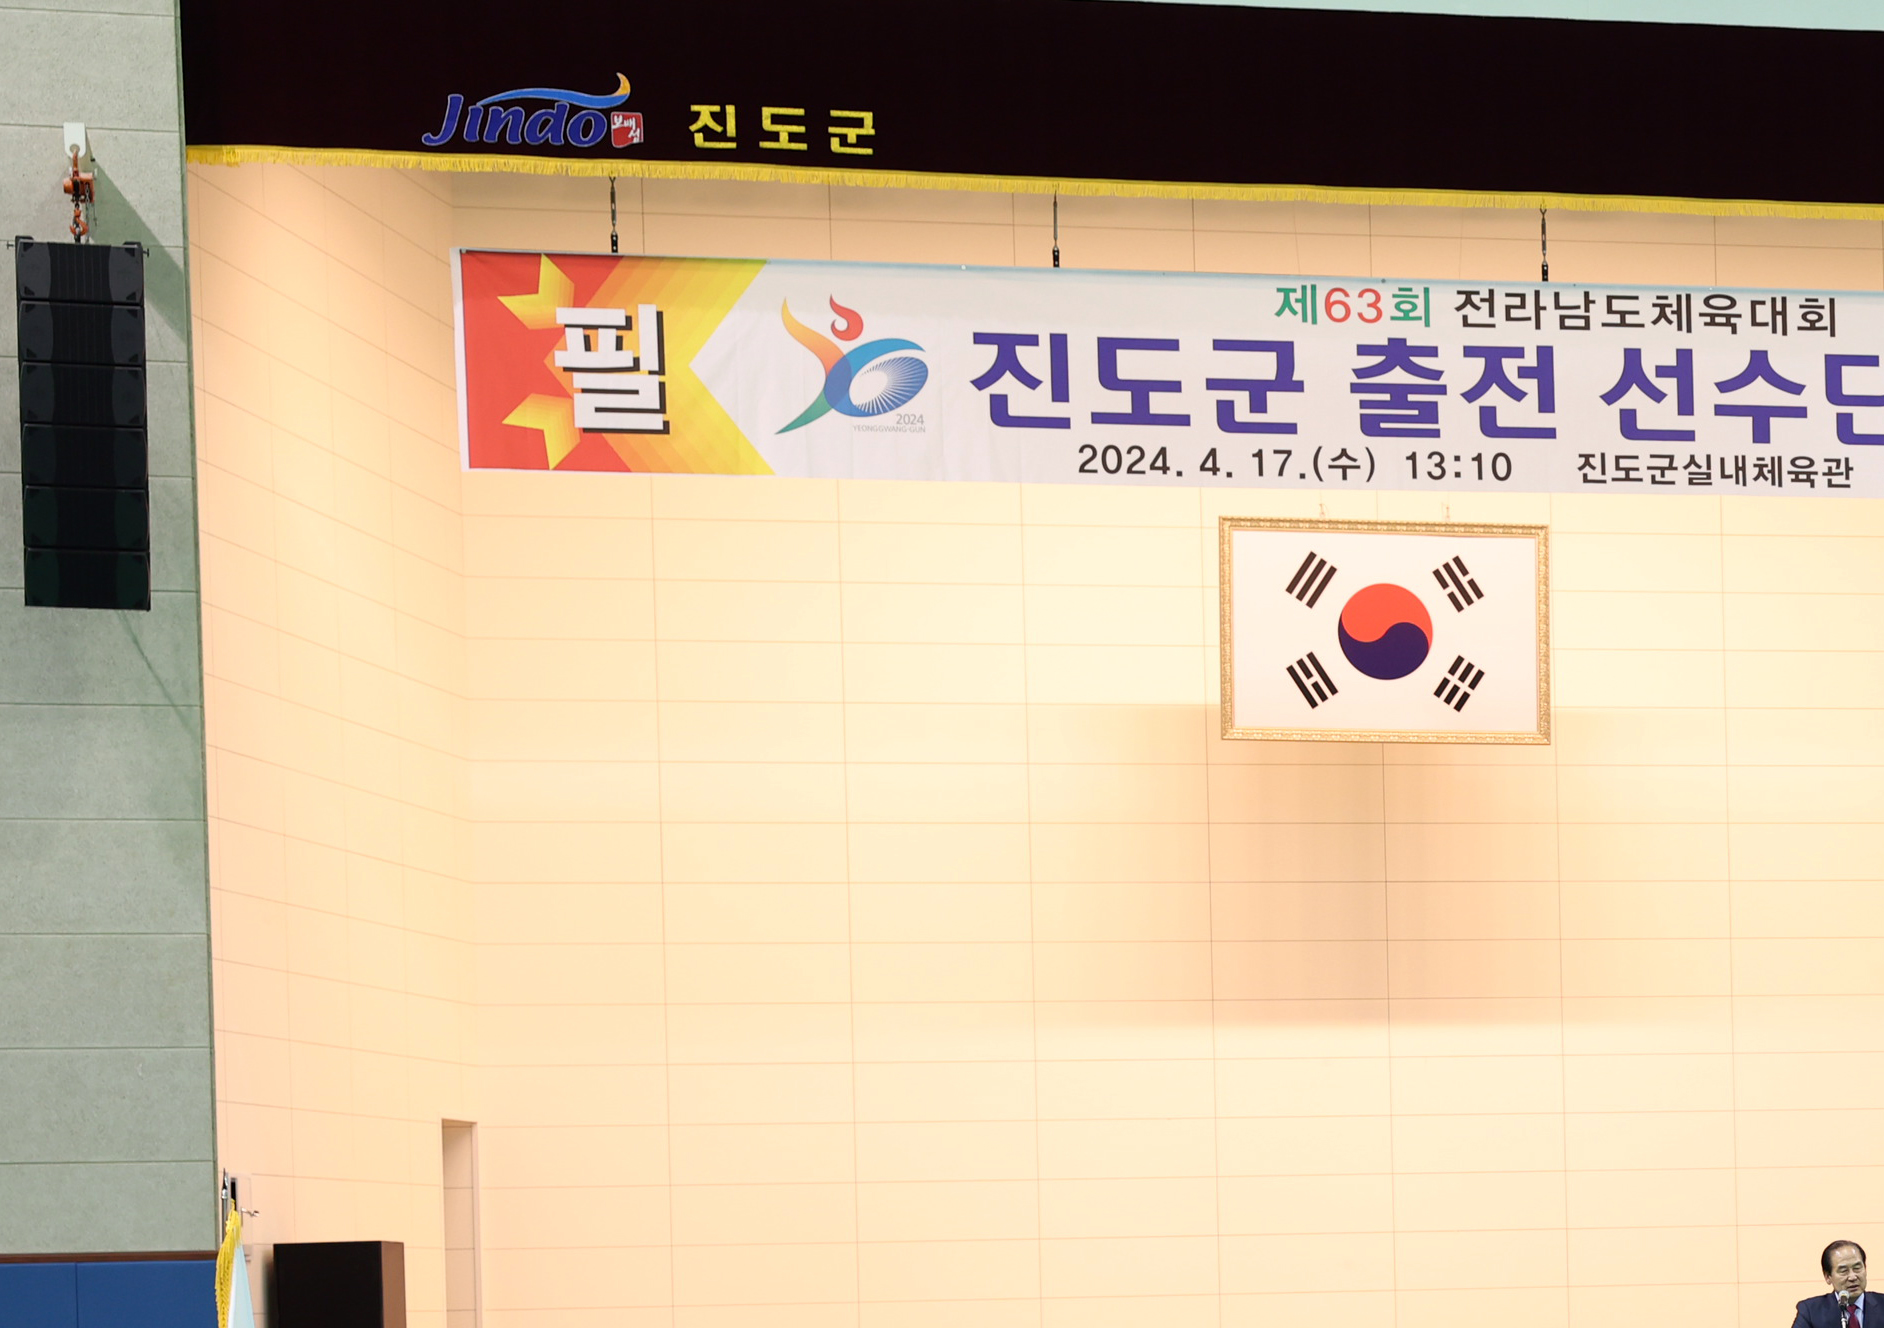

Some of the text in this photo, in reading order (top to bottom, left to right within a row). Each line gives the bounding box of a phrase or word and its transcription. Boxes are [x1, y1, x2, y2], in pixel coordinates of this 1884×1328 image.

[421, 93, 608, 147] Jindo
[689, 104, 876, 155] 진도군
[1274, 284, 1836, 338] 제63회 전라남도체육대회
[555, 304, 669, 434] 필
[970, 332, 1305, 434] 진도군
[1350, 338, 1557, 439] 출전
[896, 414, 924, 425] 2024
[1078, 444, 1183, 477] 2024.
[1199, 447, 1233, 478] 4.
[1251, 446, 1376, 482] 17.(수)
[1405, 451, 1512, 481] 13:10
[1577, 453, 1854, 489] 진도군실내체육관
